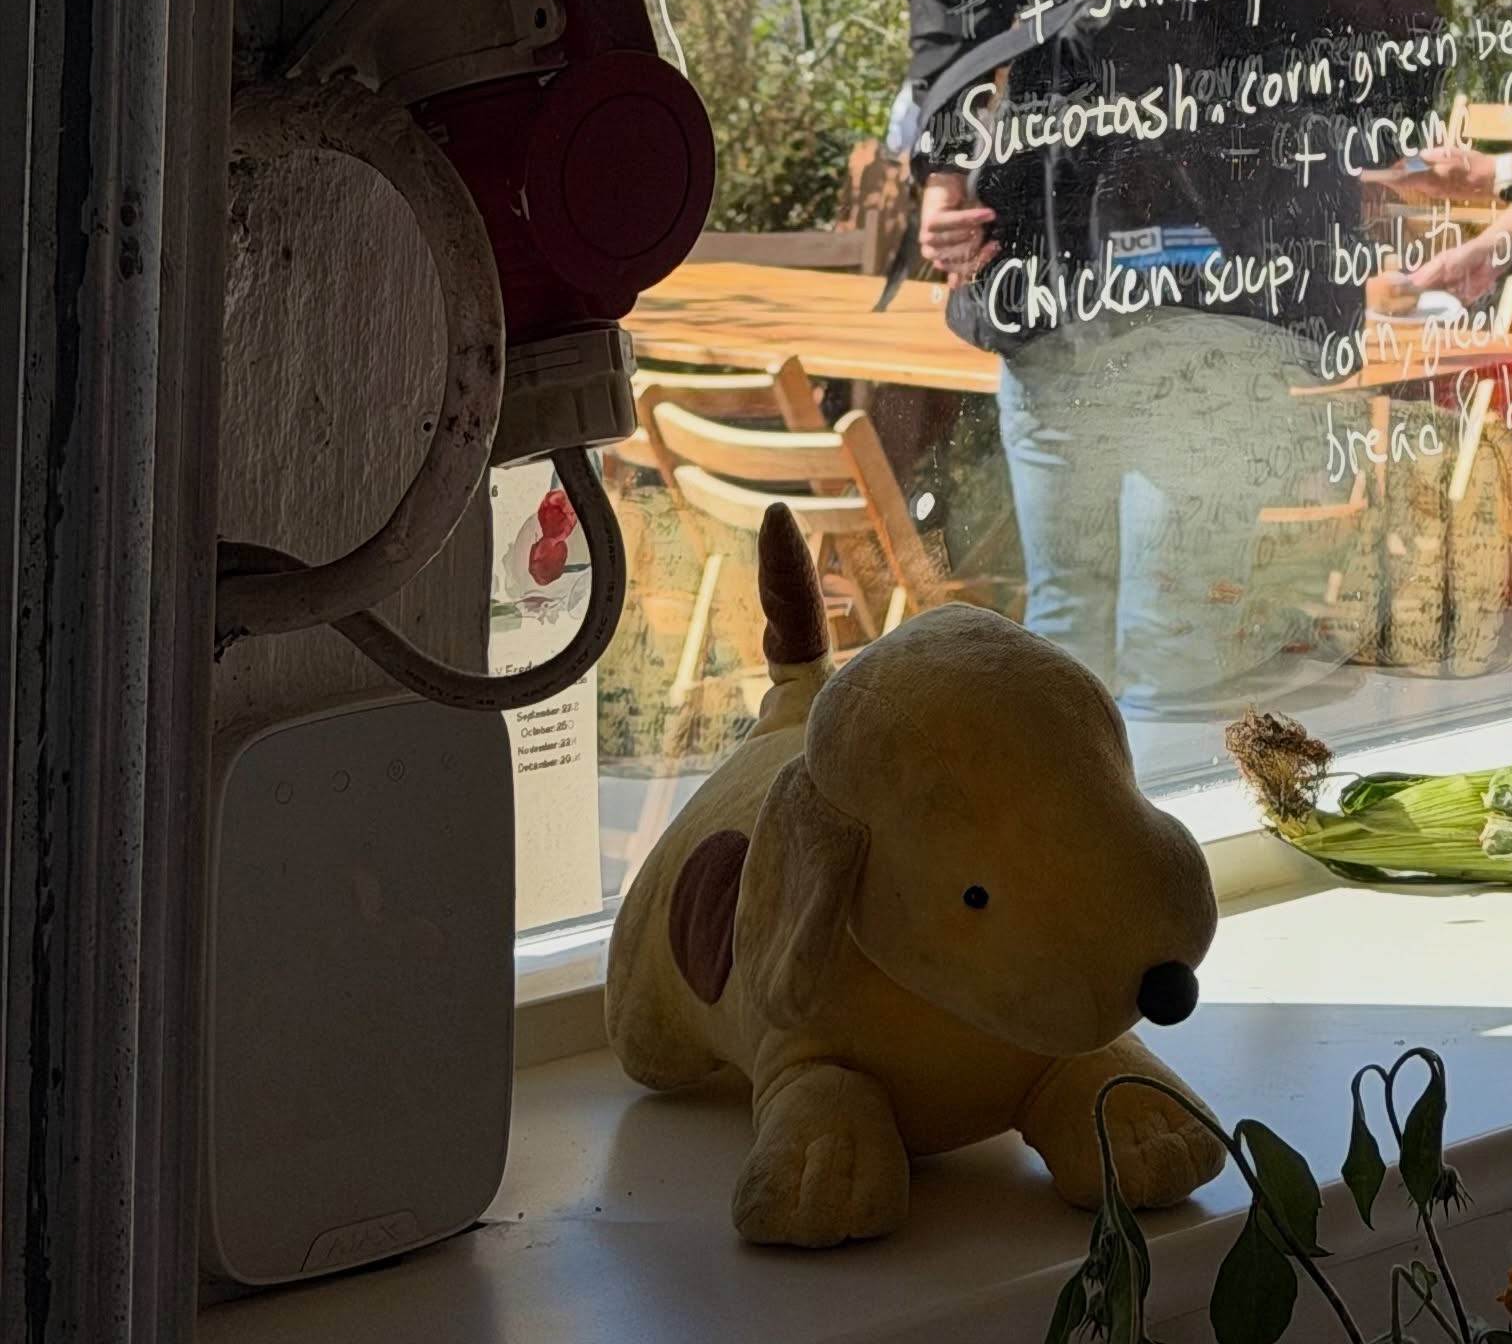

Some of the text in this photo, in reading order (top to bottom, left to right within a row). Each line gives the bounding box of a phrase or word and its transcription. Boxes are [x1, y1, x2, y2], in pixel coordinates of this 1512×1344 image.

[1353, 23, 1459, 103] green
[987, 239, 1184, 334] Chicken
[1421, 304, 1511, 378] green
[1325, 381, 1446, 483] bread
[520, 723, 556, 739] October
